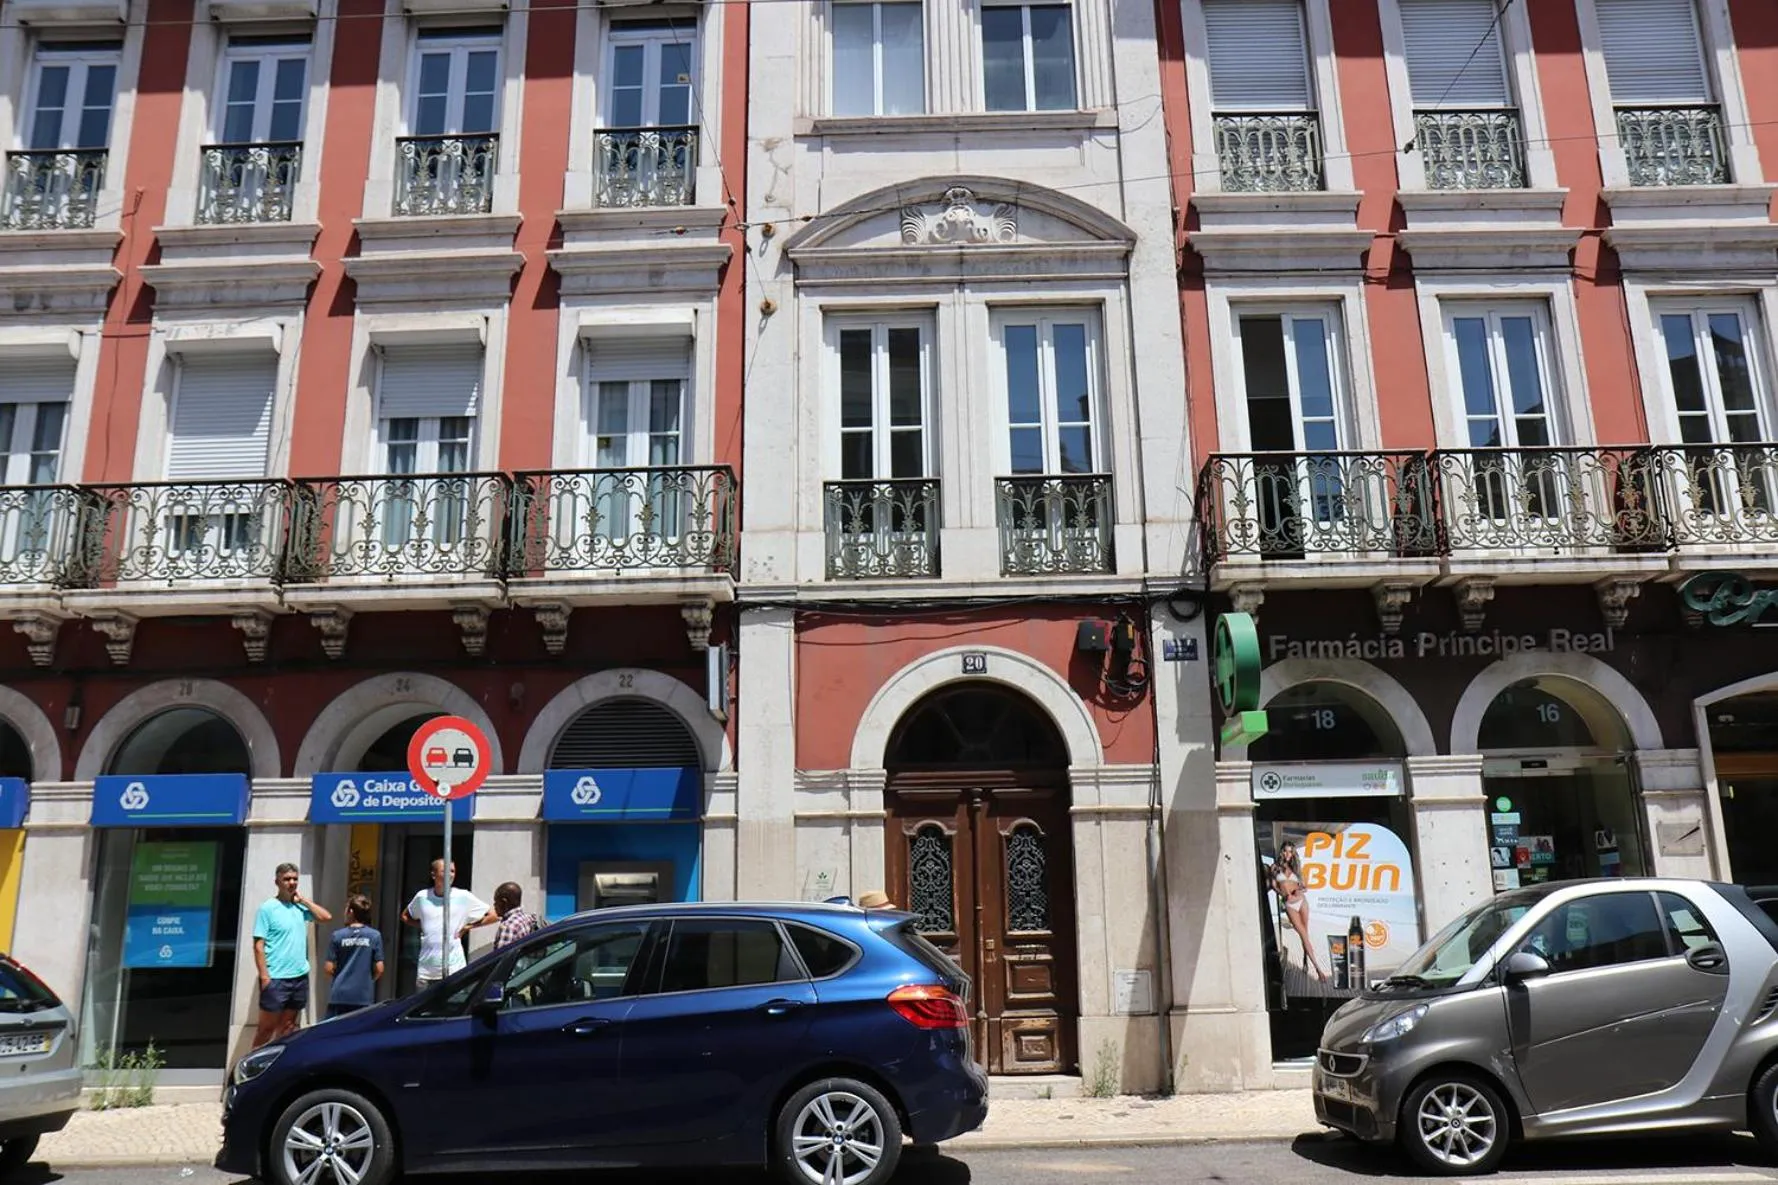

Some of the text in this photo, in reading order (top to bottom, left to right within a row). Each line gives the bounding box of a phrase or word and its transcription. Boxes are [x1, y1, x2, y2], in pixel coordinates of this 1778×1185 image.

[1269, 626, 1615, 660] Farmácia Príncipe Real
[966, 656, 983, 670] 20
[619, 673, 633, 688] 22
[1311, 710, 1335, 730] 18
[1536, 704, 1560, 723] 16
[363, 779, 405, 793] Caixa
[363, 795, 380, 808] de
[1304, 831, 1372, 859] PIZ
[1302, 863, 1401, 892] BUIN
